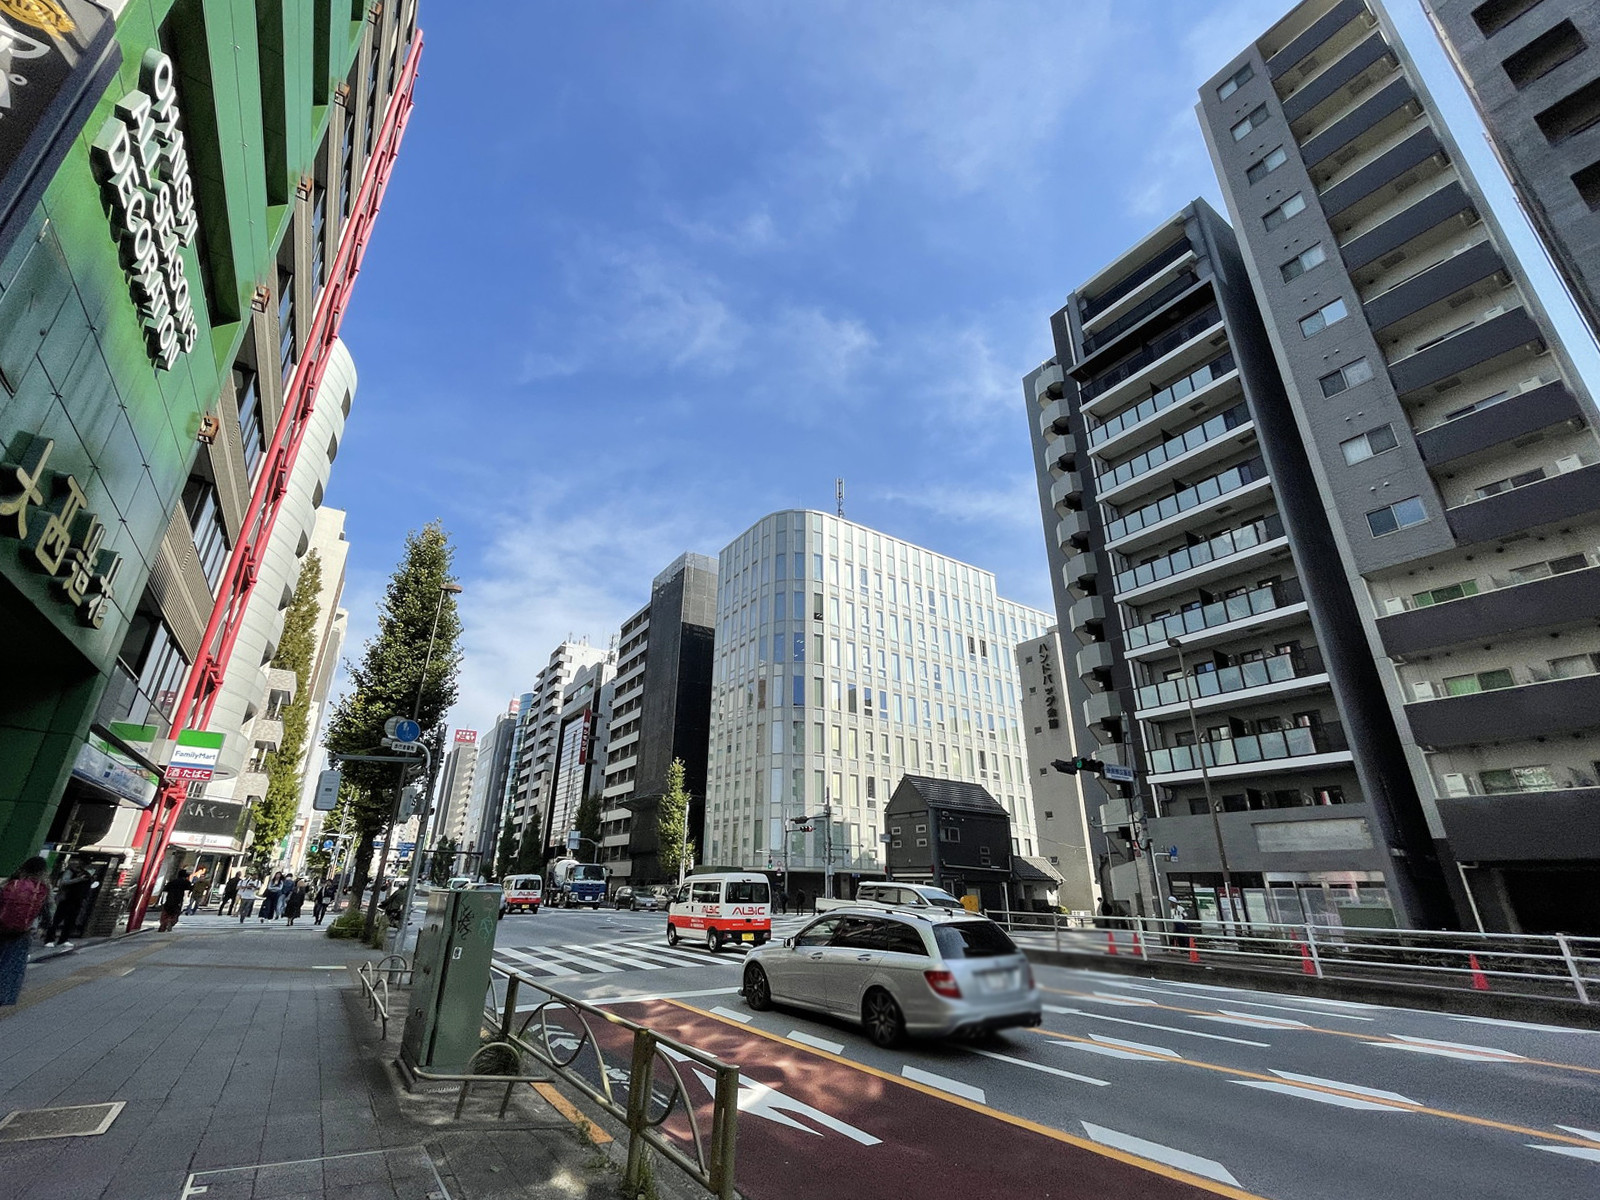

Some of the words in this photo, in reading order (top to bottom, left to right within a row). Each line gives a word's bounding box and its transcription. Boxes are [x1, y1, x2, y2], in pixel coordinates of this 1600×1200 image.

[107, 121, 181, 371] DECORATION
[0, 438, 123, 630] 大西造花
[175, 750, 216, 760] FamilyMart
[732, 906, 765, 915] ALBIC
